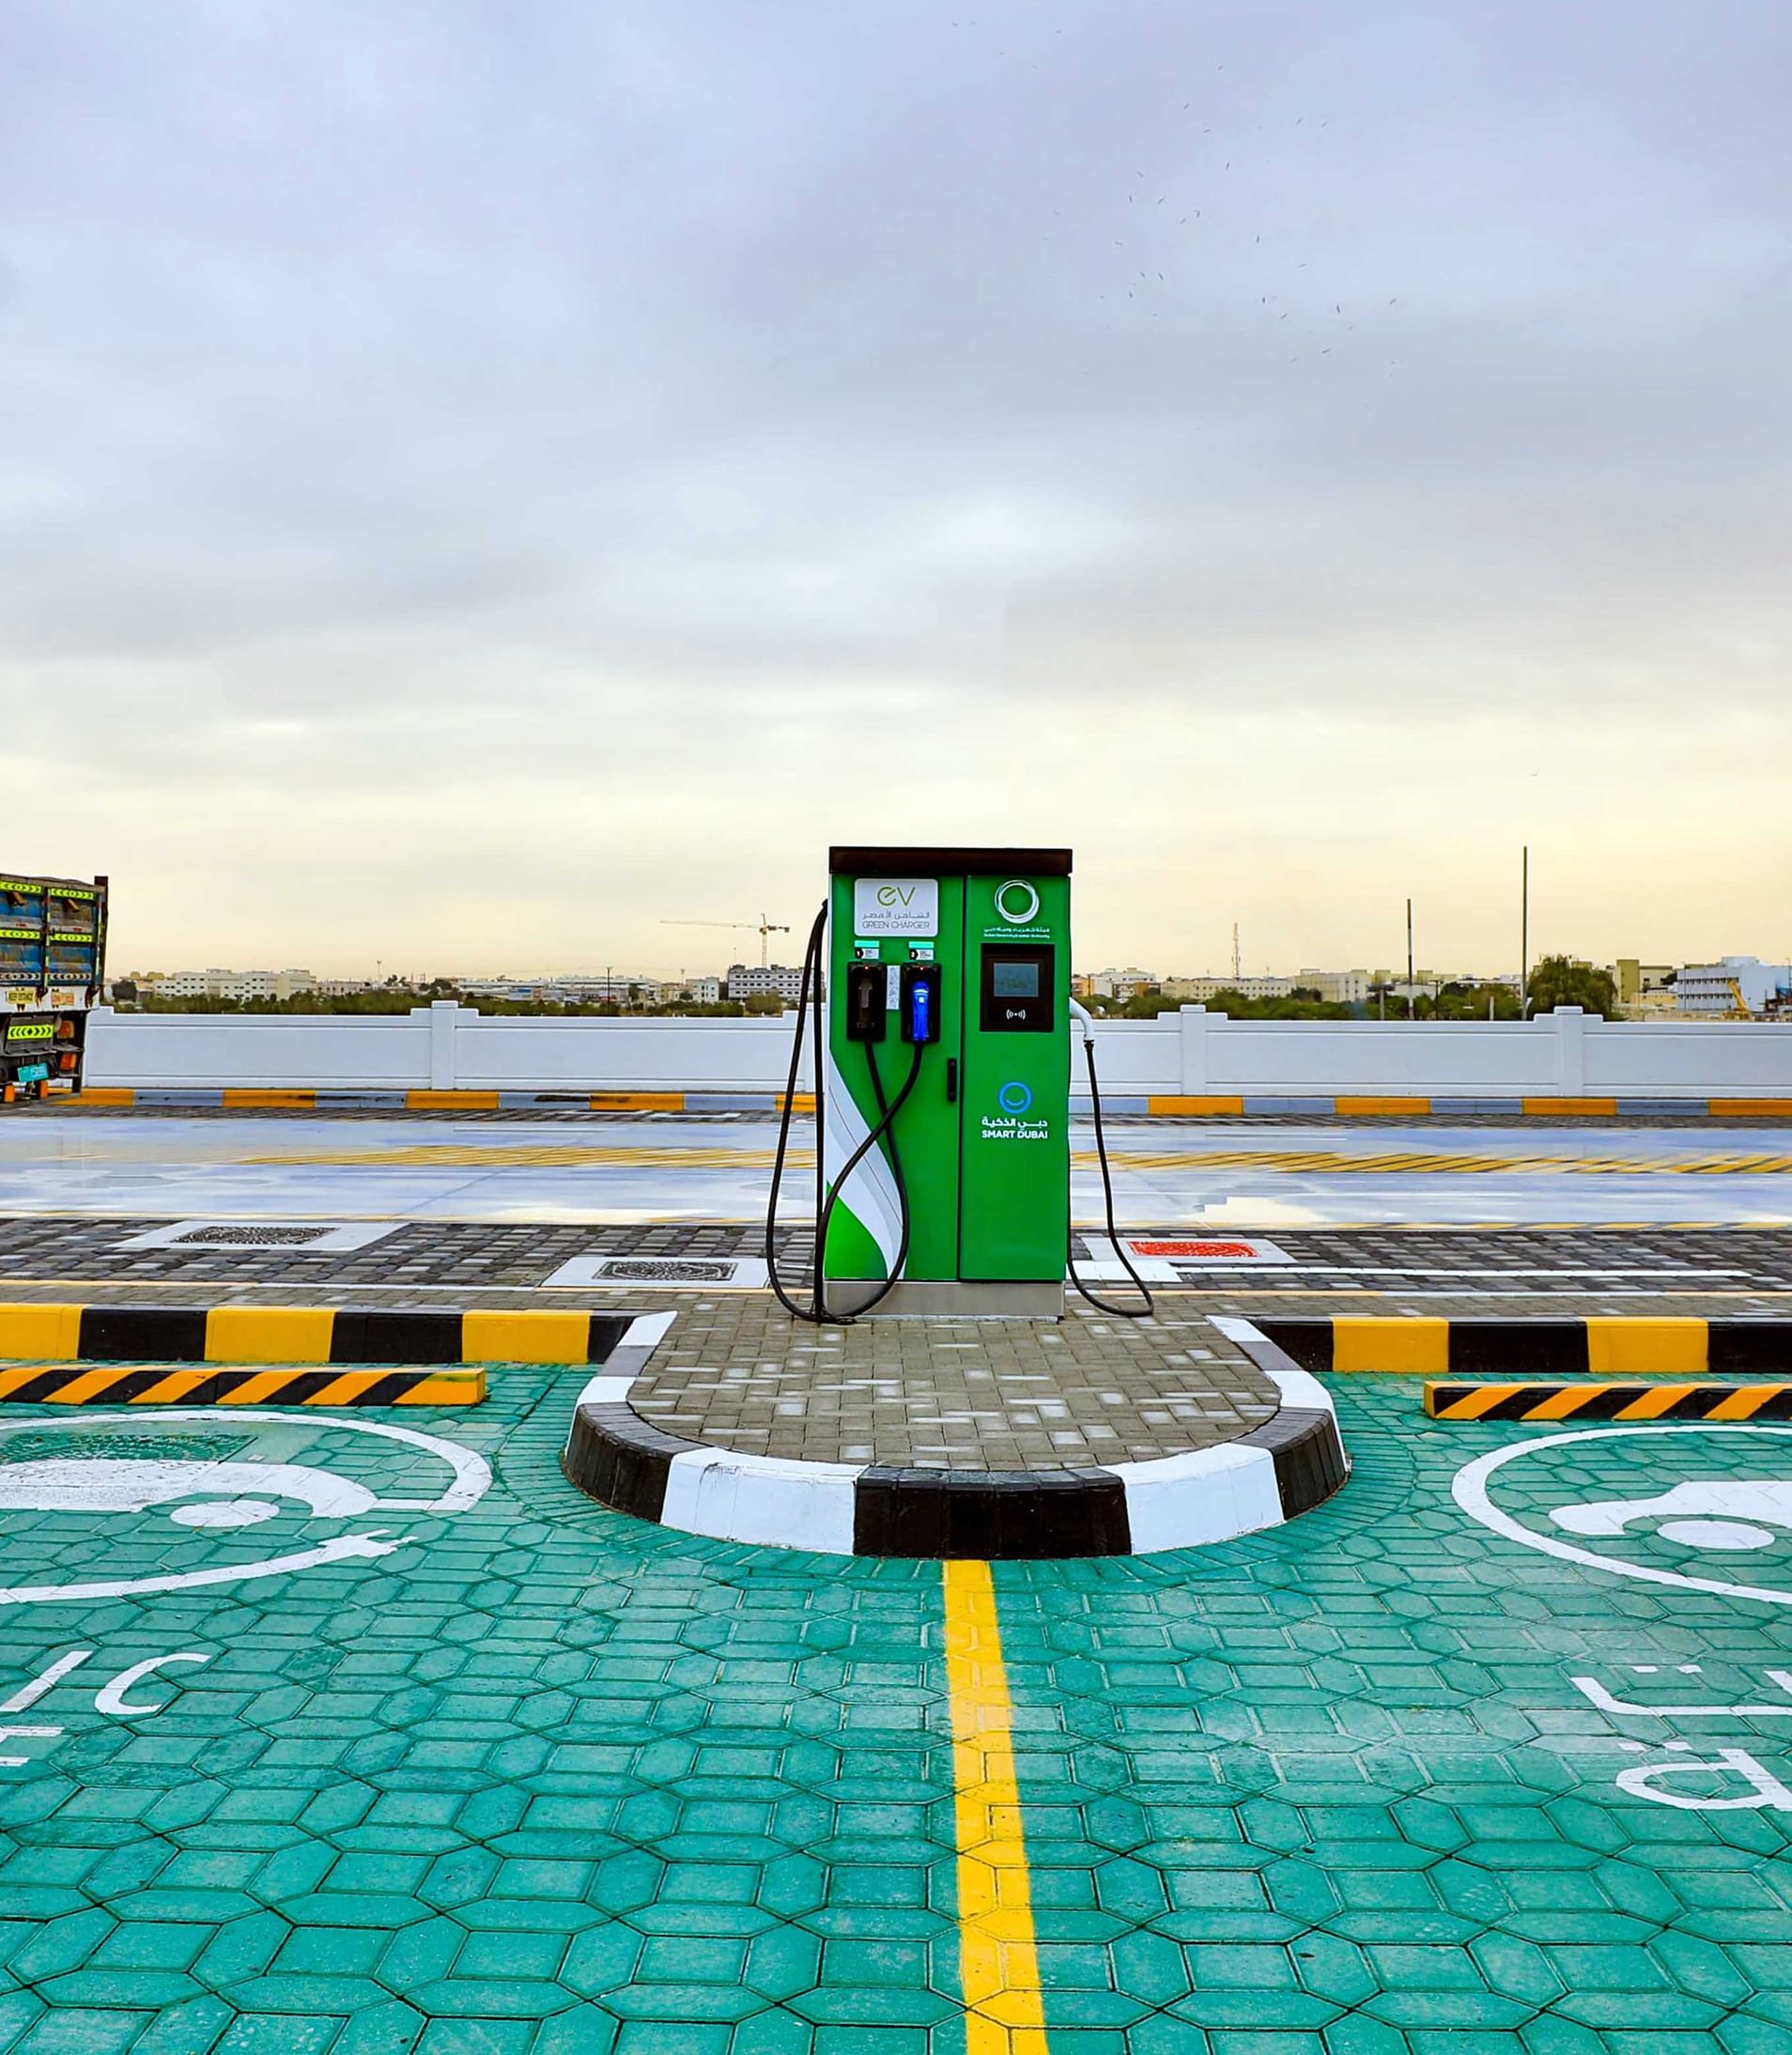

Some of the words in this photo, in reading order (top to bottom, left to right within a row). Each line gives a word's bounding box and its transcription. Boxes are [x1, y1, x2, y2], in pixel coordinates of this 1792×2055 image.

[862, 920, 889, 929] GREEN
[890, 920, 931, 929] CHARGER
[981, 1130, 1016, 1138] SMART
[1017, 1130, 1048, 1139] DUBAI
